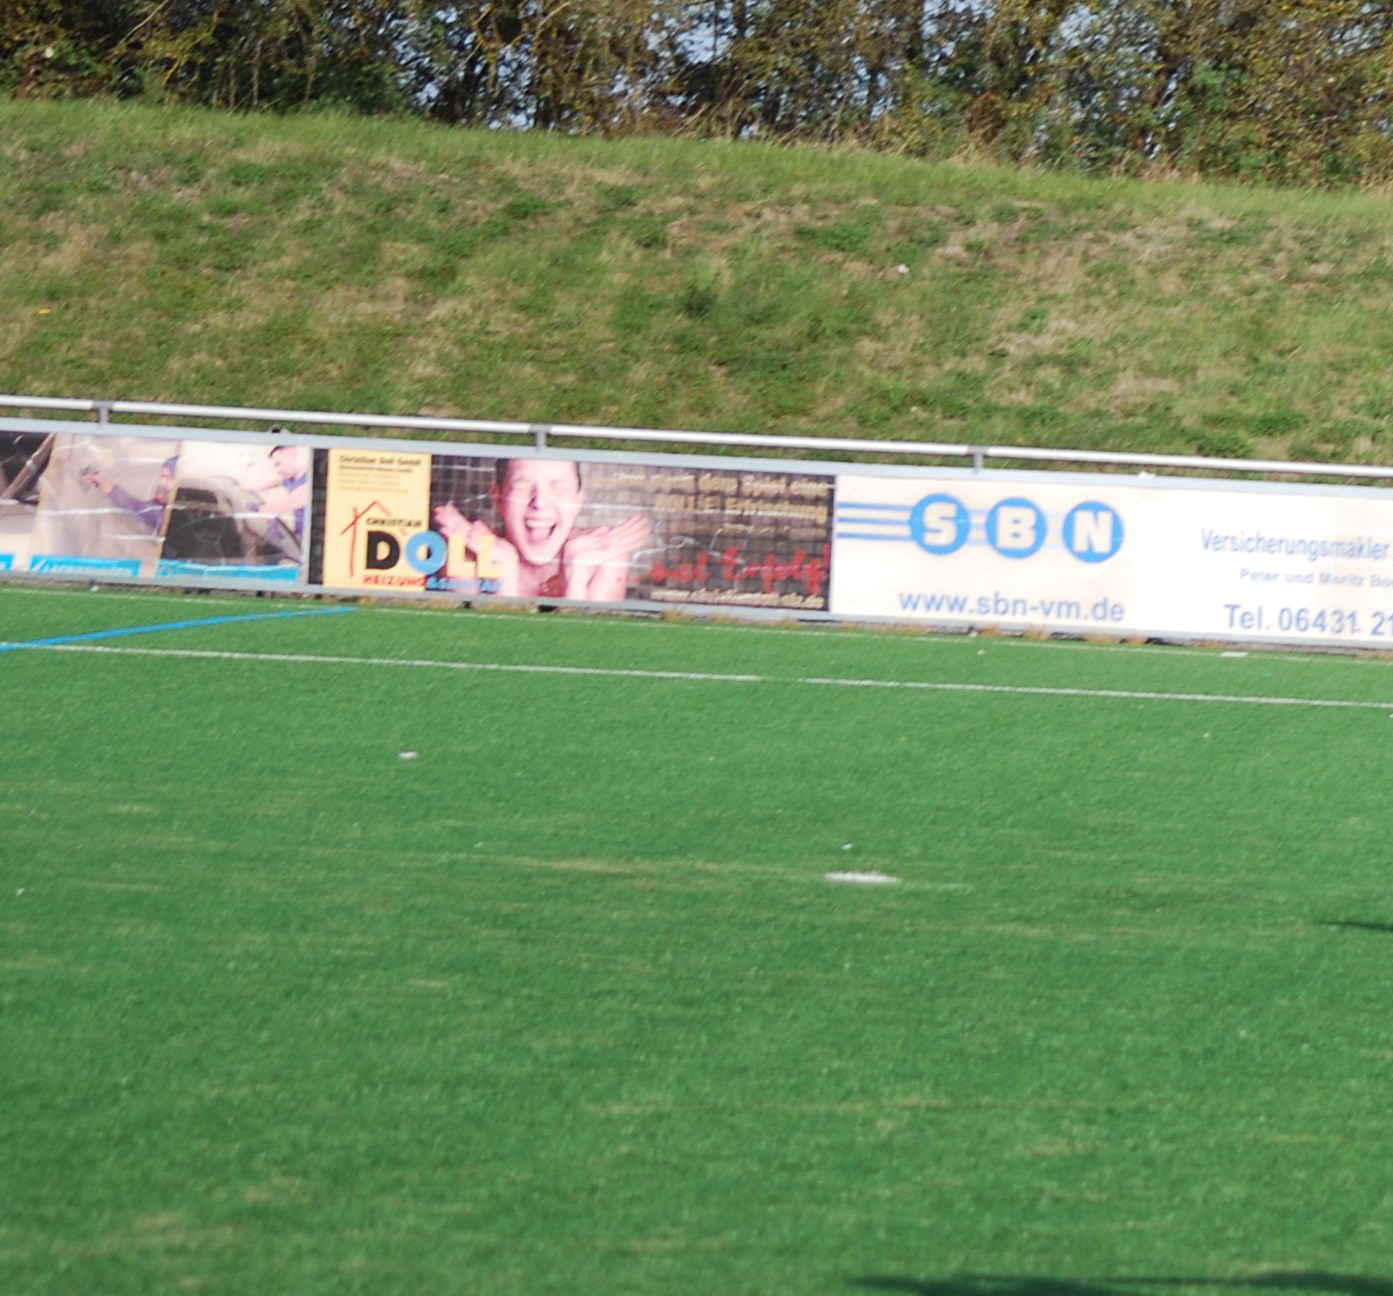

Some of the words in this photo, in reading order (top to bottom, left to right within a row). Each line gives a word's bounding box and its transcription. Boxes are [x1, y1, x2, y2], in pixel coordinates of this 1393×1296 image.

[921, 501, 1114, 555] SBN
[899, 591, 1125, 622] www.sbn-vm.de
[1223, 604, 1271, 631] Tel.
[1278, 606, 1361, 635] 06431
